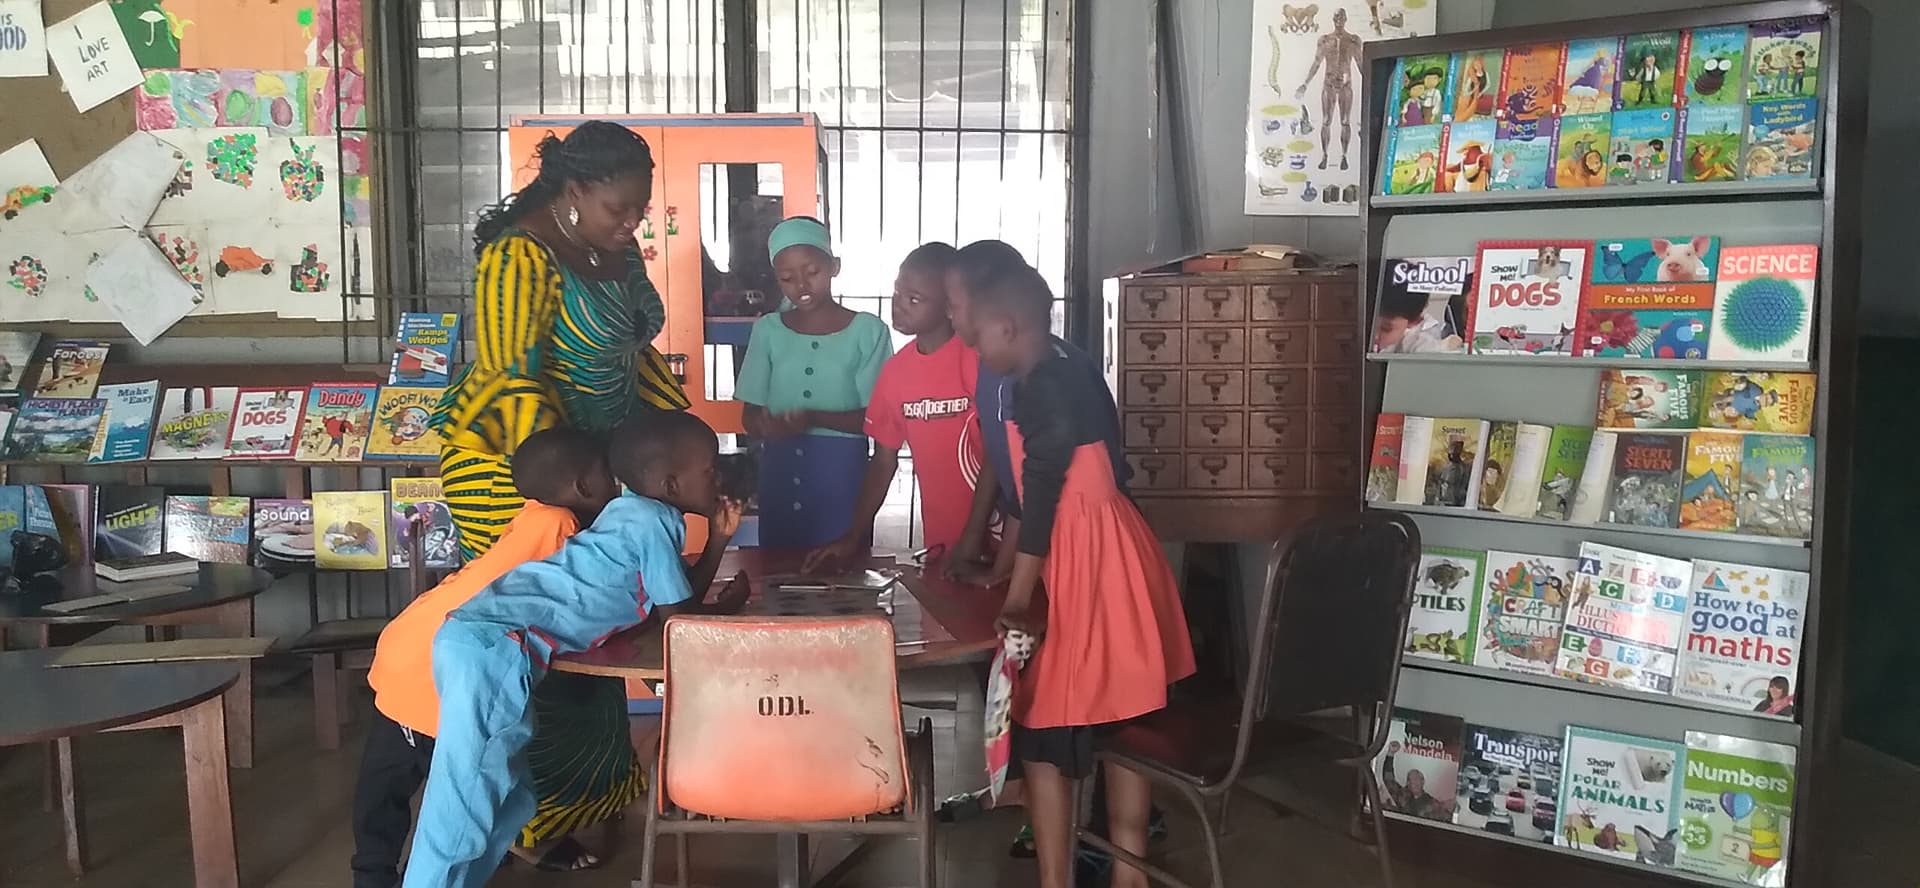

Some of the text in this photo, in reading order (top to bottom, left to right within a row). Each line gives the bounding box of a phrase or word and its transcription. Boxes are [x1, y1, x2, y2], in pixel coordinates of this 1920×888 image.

[74, 25, 83, 40] I
[78, 37, 110, 63] LOVE
[87, 60, 110, 83] ART
[1393, 260, 1467, 285] School
[1723, 254, 1813, 275] SCIENCE
[1489, 282, 1562, 308] DOGS
[1604, 294, 1696, 304] French Words
[408, 336, 448, 345] Wedges
[53, 348, 103, 360] Forces
[118, 387, 149, 397] Make
[318, 390, 366, 408] Dandy
[1676, 374, 1689, 420] FAMOUS
[1788, 379, 1799, 425] FAMOUS
[1668, 389, 1680, 418] FIVE
[1778, 393, 1789, 422] FIVE
[162, 410, 228, 433] MAGNETS
[242, 410, 287, 426] DOGS
[1627, 446, 1672, 458] SECRET
[1694, 445, 1742, 456] FAMOU
[1625, 458, 1672, 469] SEVEN
[105, 505, 160, 532] LIGHT
[260, 508, 310, 521] Sound
[1581, 561, 1595, 574] A
[1606, 583, 1618, 597] C
[1412, 593, 1466, 612] PTILES
[1504, 597, 1560, 618] CRAFT
[1661, 595, 1674, 609] D
[1693, 591, 1799, 620] How to be
[1499, 616, 1562, 639] SMART
[1692, 609, 1797, 639] good at
[1568, 636, 1580, 650] E
[1687, 632, 1793, 666] maths
[1590, 661, 1602, 675] G
[1405, 732, 1444, 749] Nelson
[1474, 732, 1559, 765] Transpor
[1573, 774, 1621, 789] POLAR
[1687, 760, 1789, 793] Numbers
[1571, 786, 1665, 813] ANIMALS
